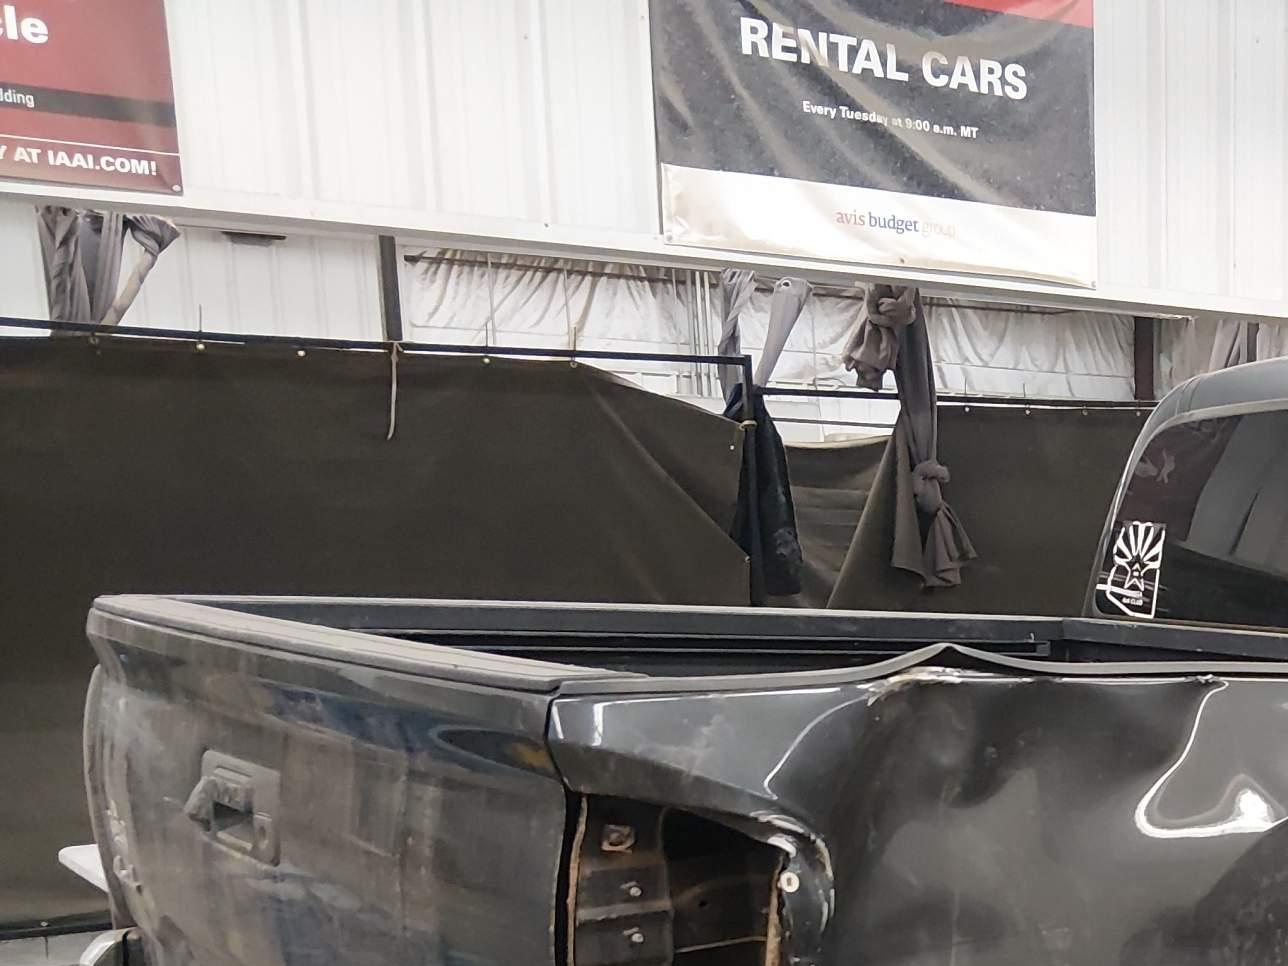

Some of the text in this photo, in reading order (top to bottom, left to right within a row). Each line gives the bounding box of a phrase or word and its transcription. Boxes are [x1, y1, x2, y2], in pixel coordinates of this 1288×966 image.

[0, 5, 49, 43] le
[740, 16, 1028, 100] RENTAL CARS
[802, 100, 980, 139] Every Tuesday at 9:00 a.m. MT
[14, 146, 42, 164] AT
[48, 149, 157, 176] IAAI.COM!
[836, 209, 865, 227] avis
[868, 212, 919, 234] budget
